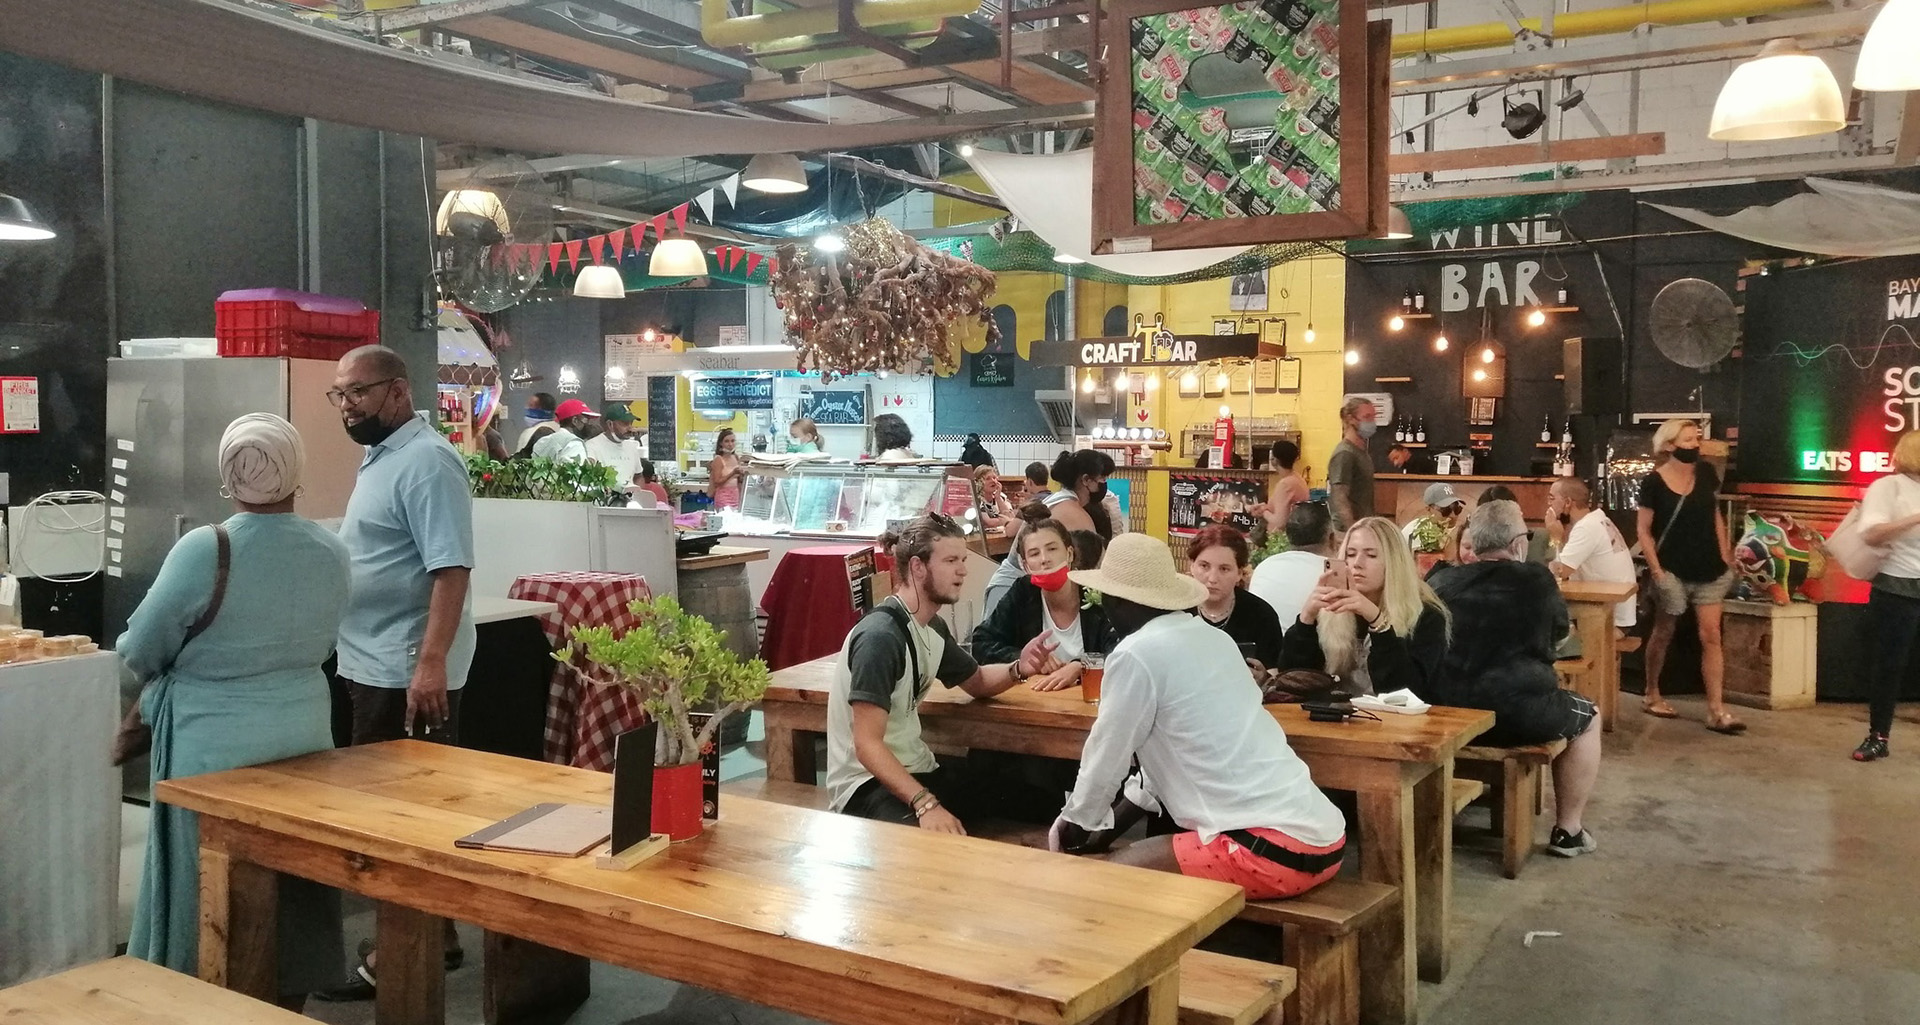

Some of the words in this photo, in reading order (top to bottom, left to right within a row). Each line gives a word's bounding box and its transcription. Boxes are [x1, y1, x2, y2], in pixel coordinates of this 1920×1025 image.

[1441, 261, 1542, 312] BAR
[700, 354, 740, 370] seabar
[1081, 342, 1141, 364] CRAFT
[696, 385, 723, 397] EGGS
[727, 384, 771, 396] BENEDICT
[1802, 451, 1851, 471] EATS
